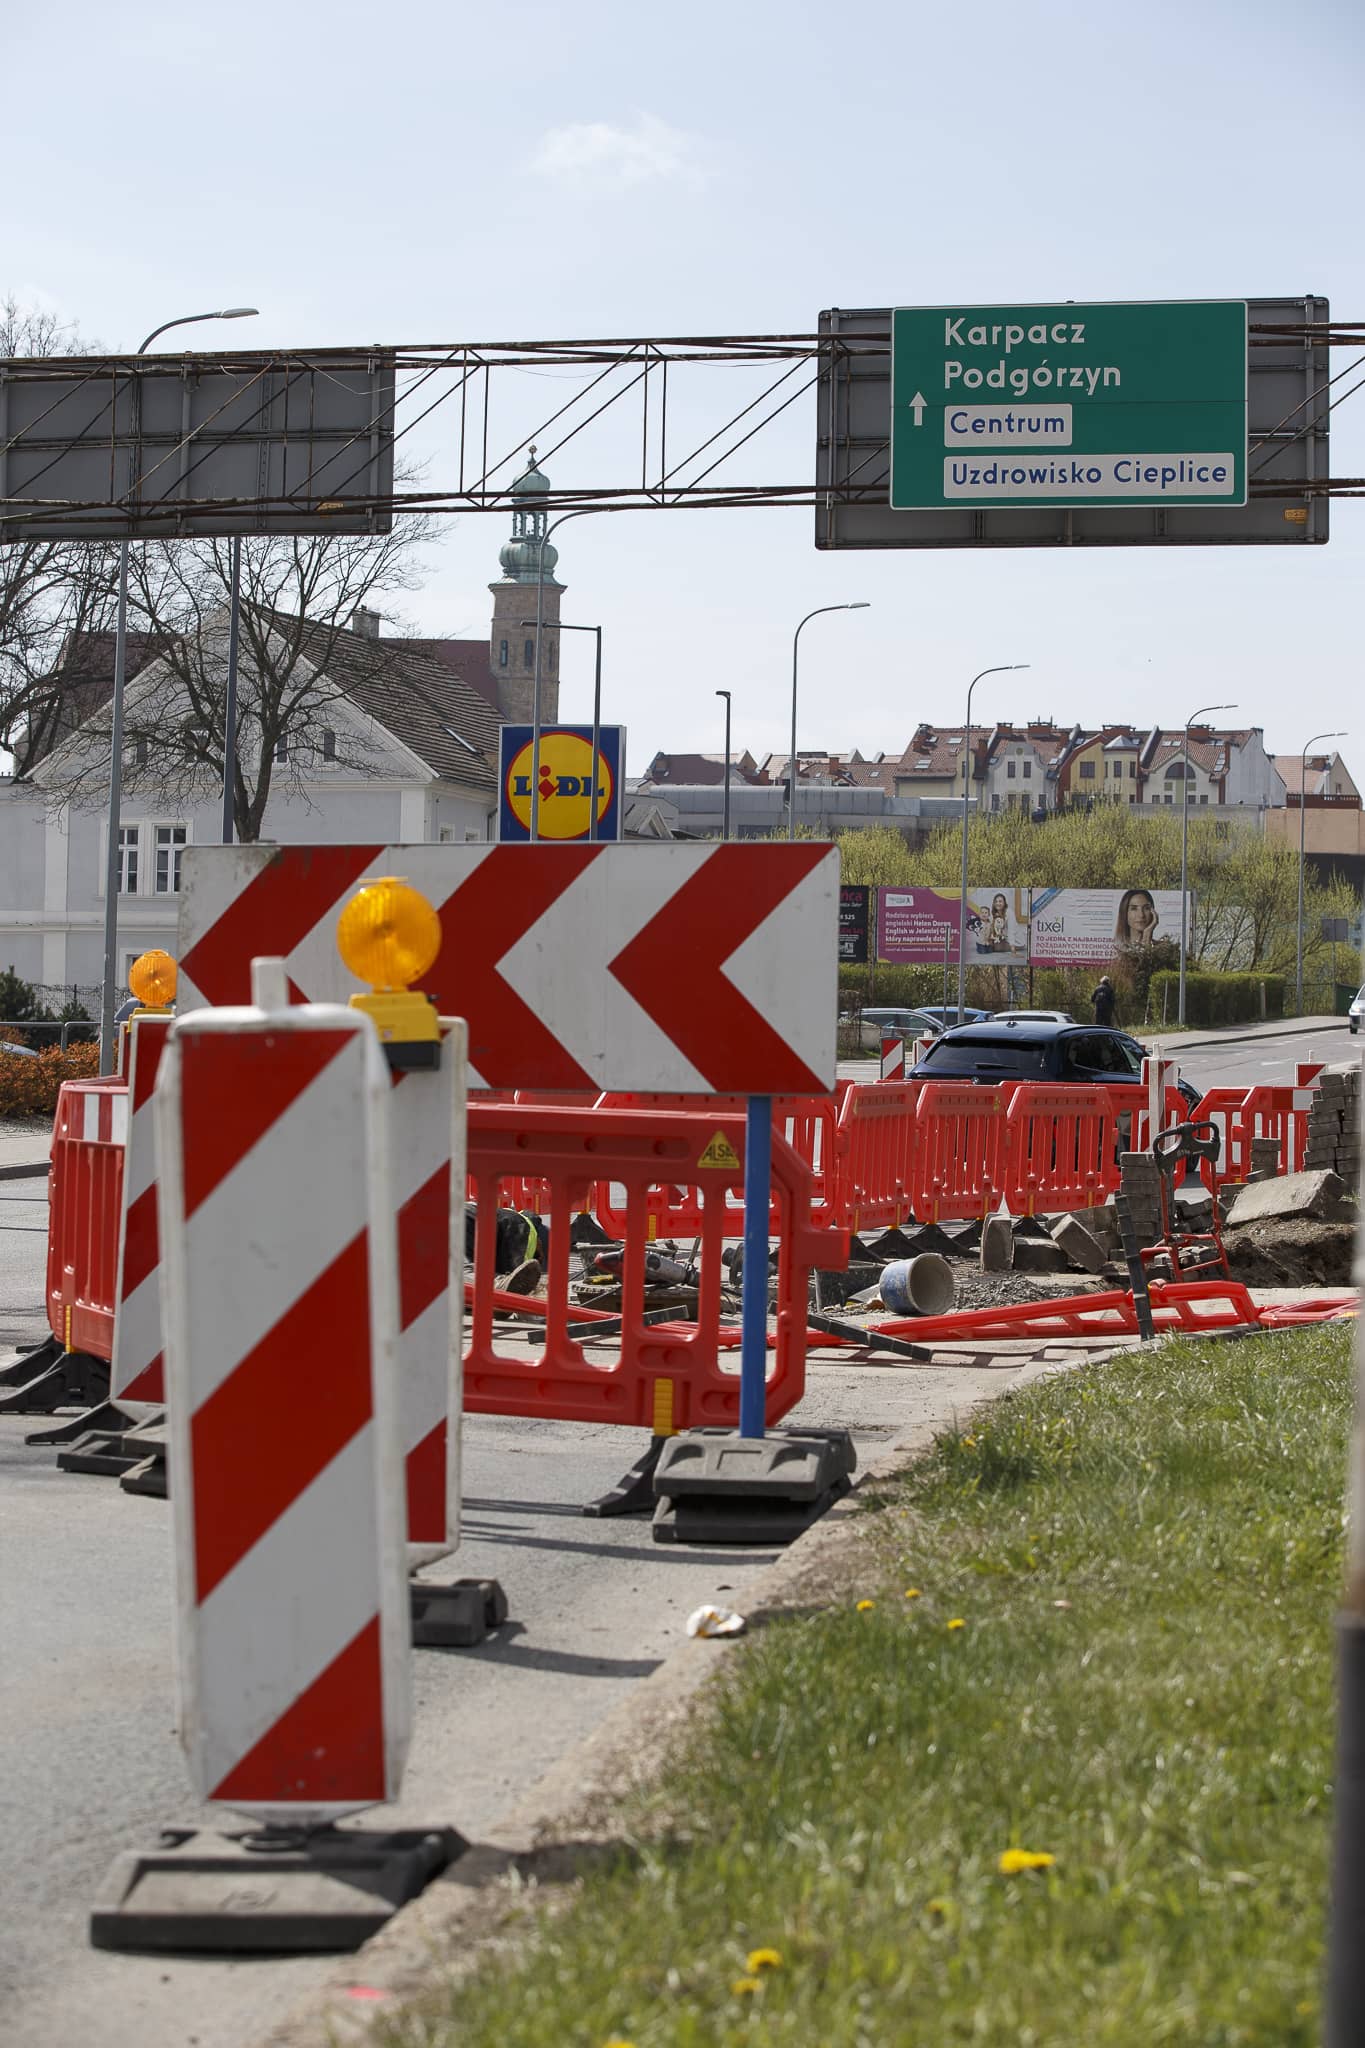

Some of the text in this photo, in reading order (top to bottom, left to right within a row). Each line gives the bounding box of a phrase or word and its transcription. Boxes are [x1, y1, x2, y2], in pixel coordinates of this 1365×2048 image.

[944, 317, 1086, 353] Karpacz
[944, 359, 1121, 396] Podgórzyn
[950, 411, 1065, 434] Centrum
[952, 460, 1227, 489] Uzdrowisko Cieplice
[885, 927, 908, 935] English
[913, 919, 932, 927] Helen
